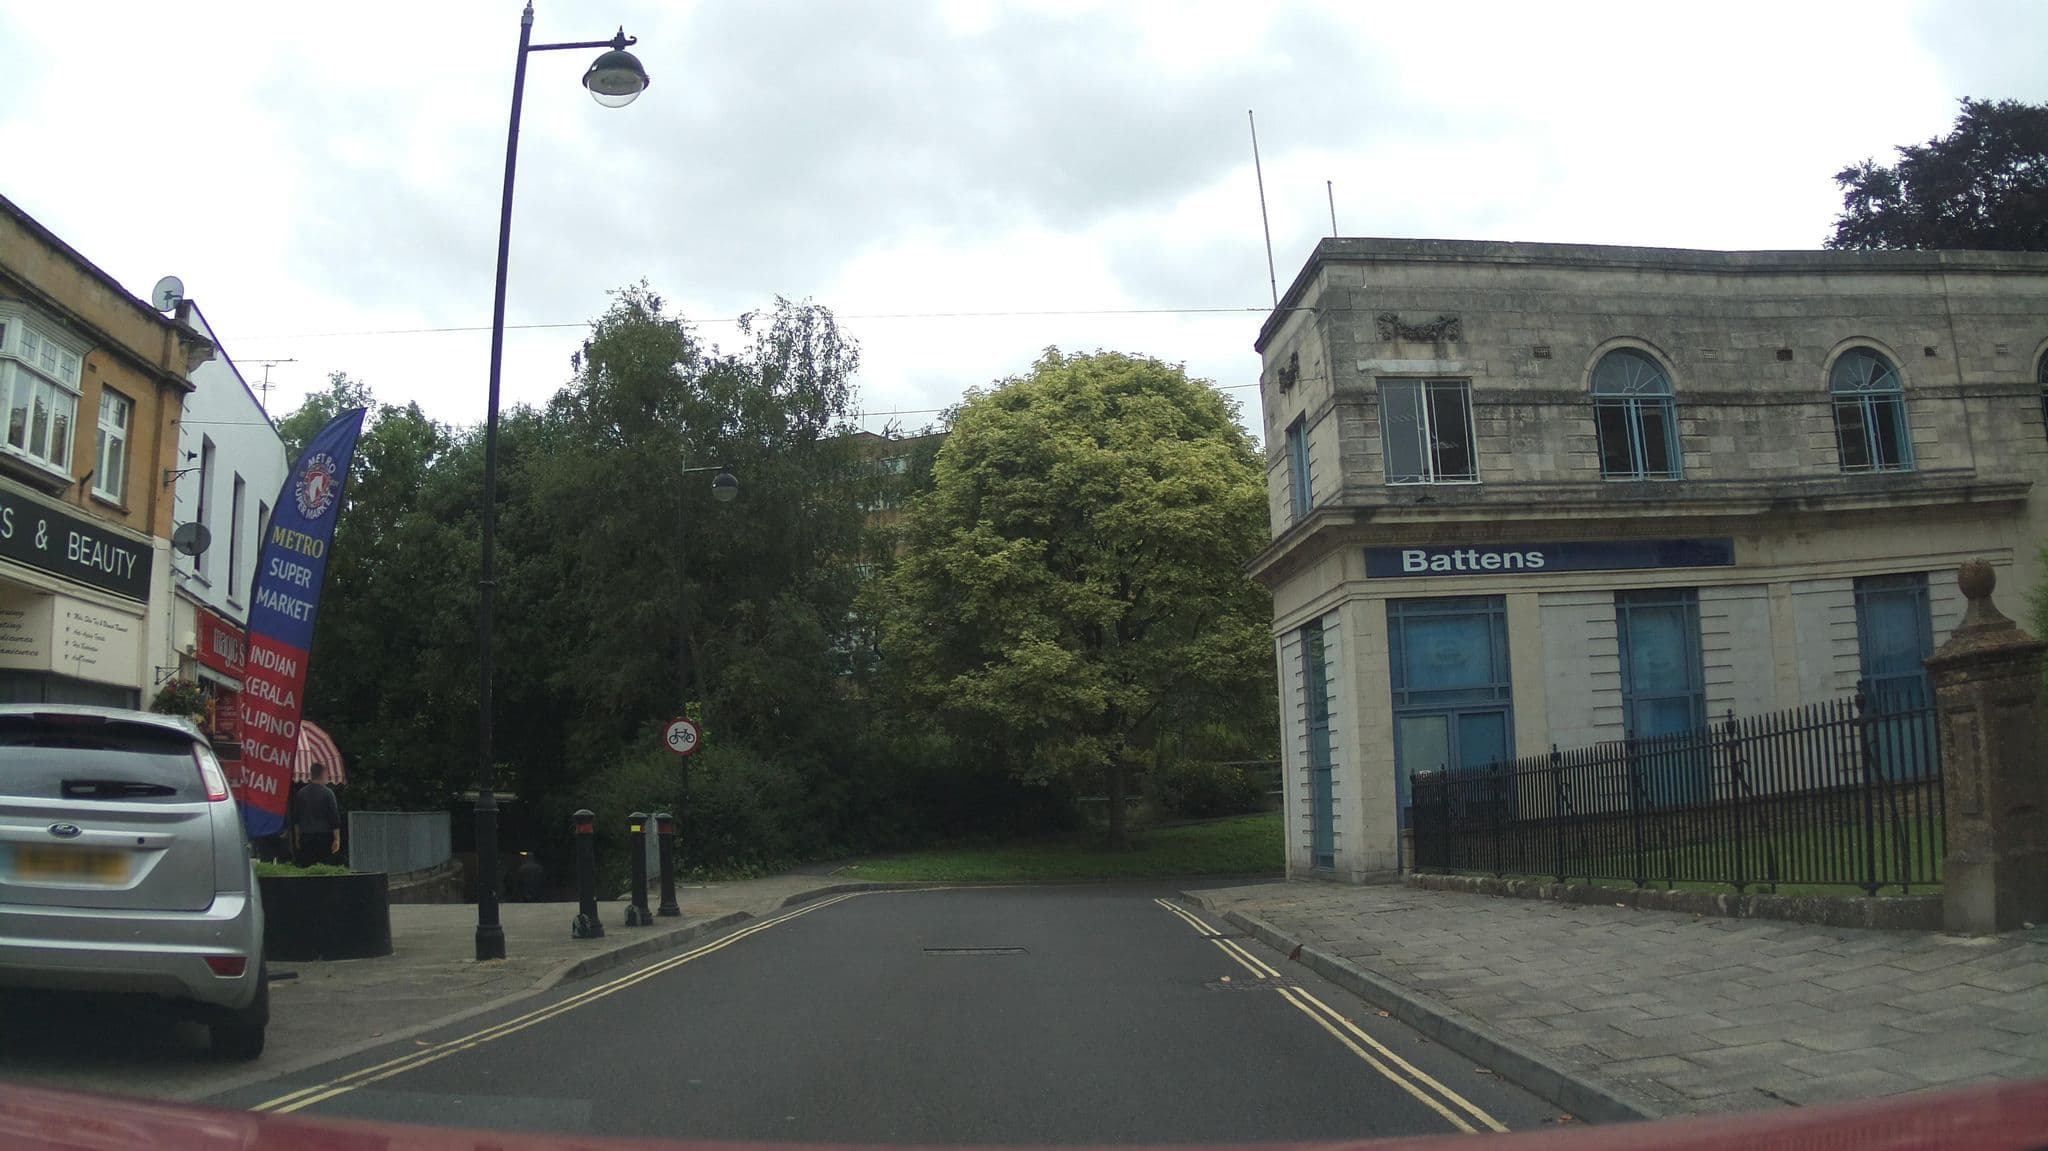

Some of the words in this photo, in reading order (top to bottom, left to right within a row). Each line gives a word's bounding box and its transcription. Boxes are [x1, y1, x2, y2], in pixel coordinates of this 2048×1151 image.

[308, 453, 336, 474] METRO
[295, 481, 307, 515] SUPER
[35, 519, 48, 551] &
[67, 531, 137, 579] BEAUTY
[271, 526, 324, 559] METRO
[269, 557, 312, 588] SUPER
[1402, 549, 1545, 572] Battens
[256, 586, 313, 622] MARKET
[250, 645, 296, 679] INDIAN
